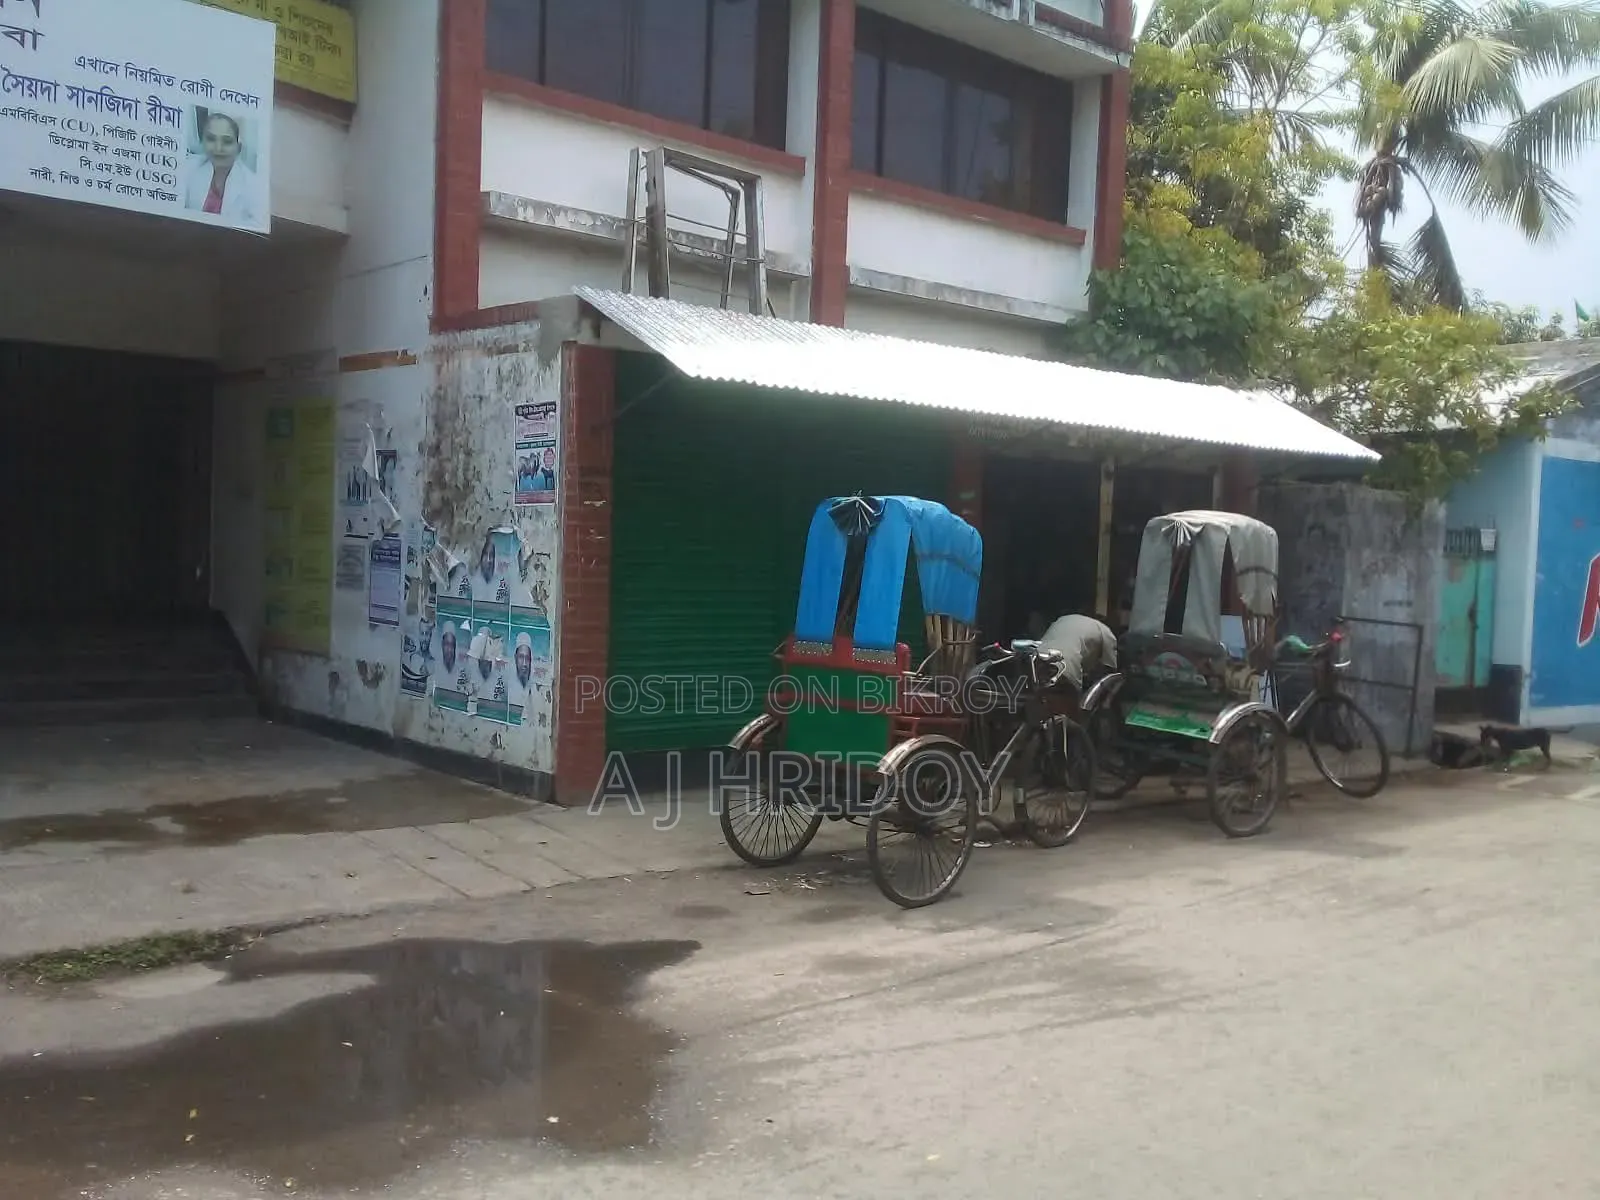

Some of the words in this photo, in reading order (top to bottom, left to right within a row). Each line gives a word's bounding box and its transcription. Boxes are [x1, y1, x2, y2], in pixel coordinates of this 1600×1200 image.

[0, 24, 45, 51] বা
[74, 55, 120, 77] এখানে
[124, 62, 177, 87] নিয়মিত
[180, 78, 215, 100] রোগী
[219, 88, 260, 109] দেখেন
[0, 63, 60, 104] সৈয়দা
[65, 85, 141, 121] সানজিদা
[146, 95, 183, 129] রীমা
[145, 151, 178, 170] (UK)
[136, 168, 178, 188] (USG)
